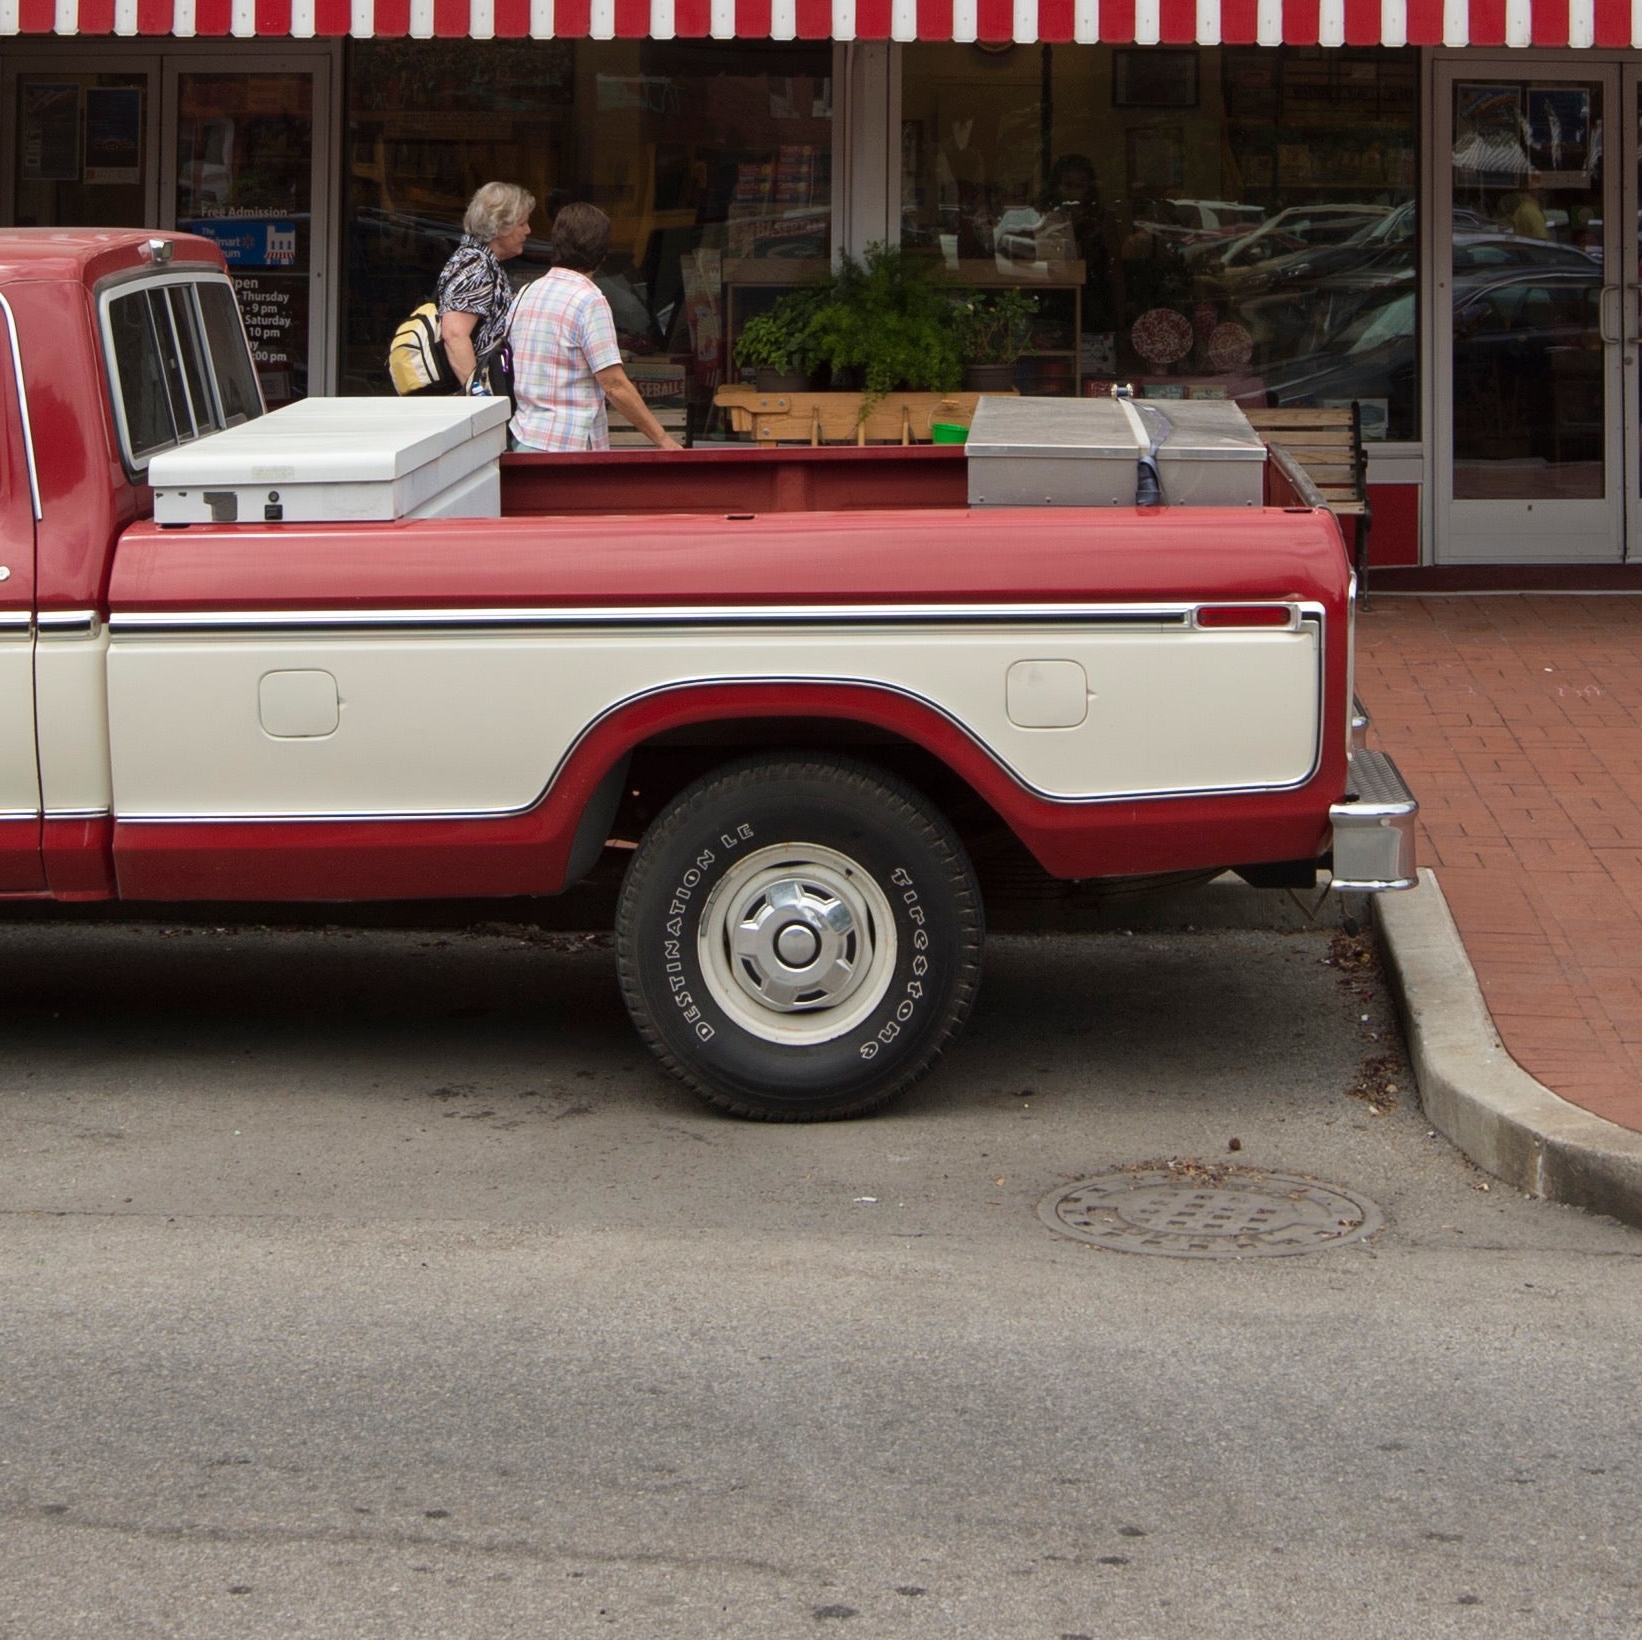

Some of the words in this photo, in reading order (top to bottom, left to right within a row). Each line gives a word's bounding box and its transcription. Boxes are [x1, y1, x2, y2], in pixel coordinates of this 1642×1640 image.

[201, 207, 226, 218] Free
[228, 206, 288, 218] Admission
[242, 291, 289, 303] Thursday
[261, 306, 278, 315] pm
[245, 314, 291, 327] Saturday
[249, 327, 262, 337] 10
[263, 329, 280, 339] pm
[270, 353, 287, 363] pm
[665, 849, 716, 1042] DESTINATION
[720, 823, 755, 848] LE
[860, 868, 929, 1060] Firestone
